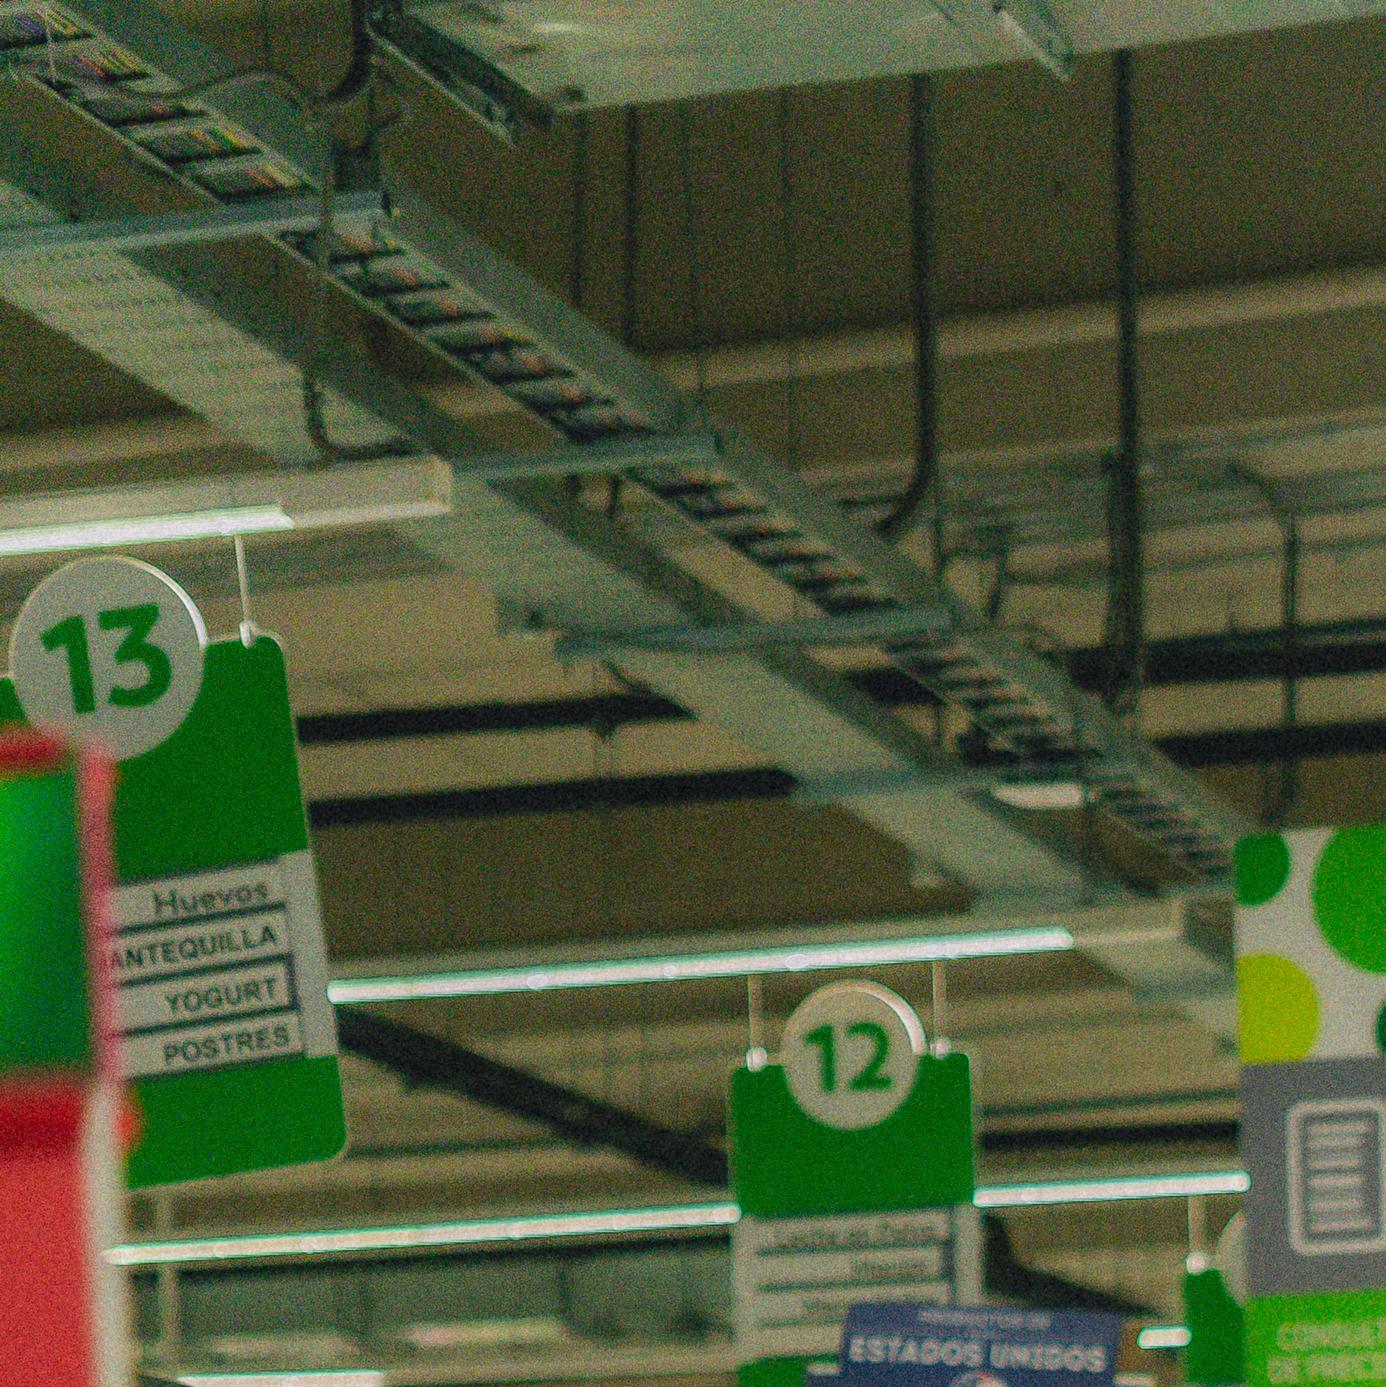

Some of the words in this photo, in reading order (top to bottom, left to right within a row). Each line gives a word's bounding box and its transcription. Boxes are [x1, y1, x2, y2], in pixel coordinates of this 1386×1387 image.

[39, 603, 173, 715] 13
[154, 882, 269, 915] Huevos
[112, 925, 278, 968] ANTEQUILLA
[165, 977, 277, 1014] YOGURT
[164, 1022, 291, 1064] POSTRES
[803, 1021, 894, 1094] 12
[850, 1335, 984, 1367] ESTADOS
[990, 1343, 1106, 1373] UNIDOS
